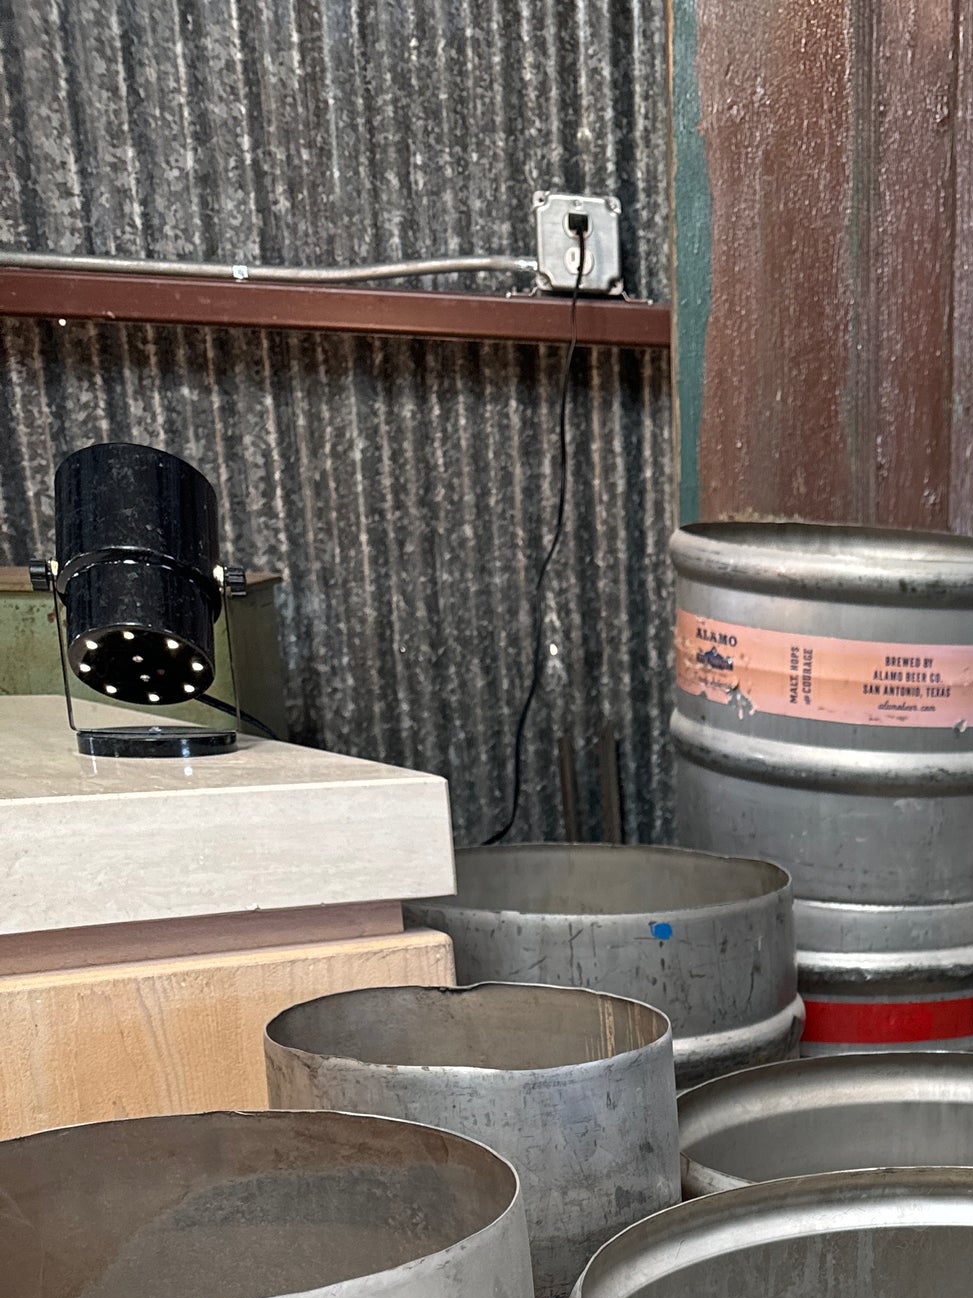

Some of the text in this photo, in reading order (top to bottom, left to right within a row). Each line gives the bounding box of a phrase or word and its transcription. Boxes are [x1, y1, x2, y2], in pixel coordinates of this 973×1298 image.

[695, 628, 737, 647] ALAMO
[790, 647, 799, 670] HOPS
[885, 656, 933, 668] BREWED BY
[802, 649, 812, 693] COURAGE
[873, 671, 943, 683] ALAMO BEER CO.
[863, 685, 950, 698] SAN ANTONIO, TEXAS
